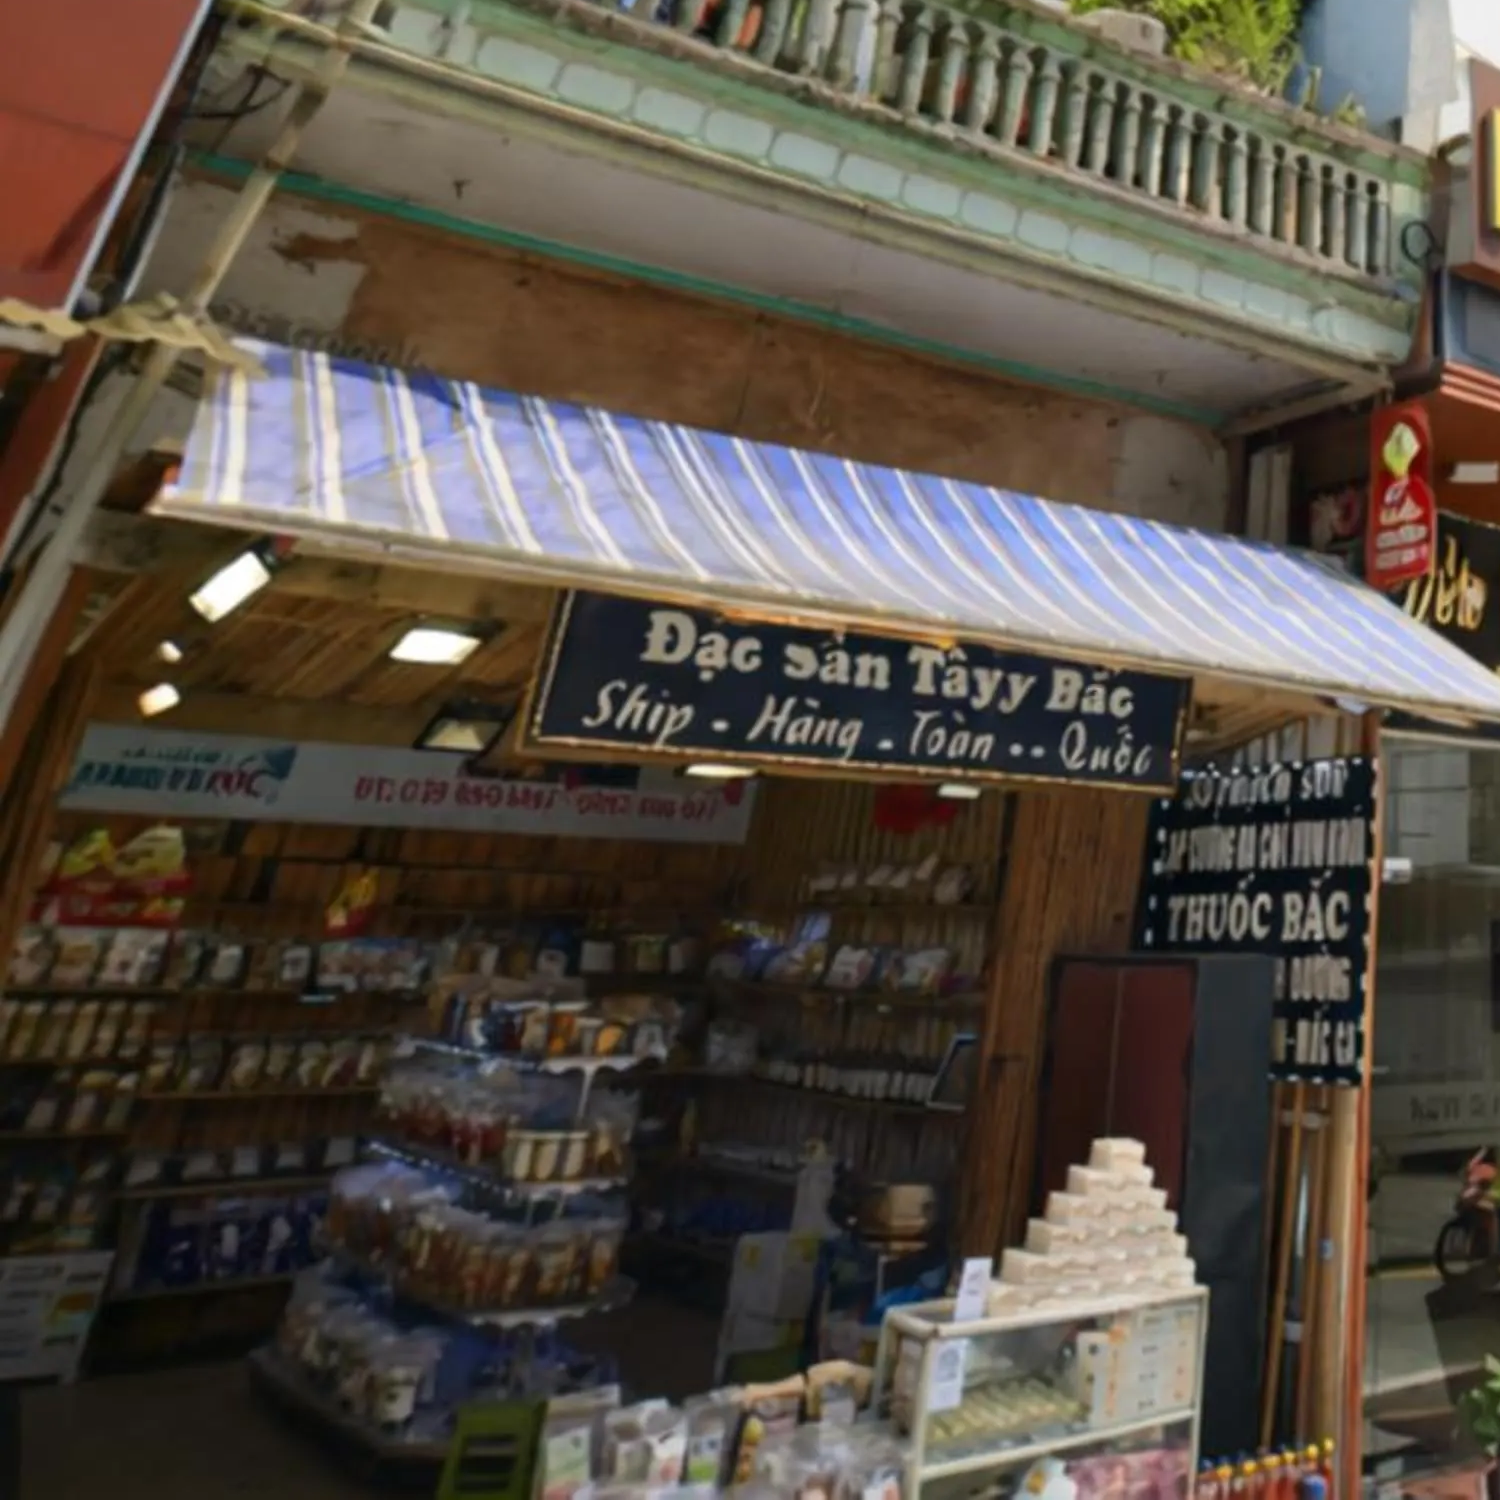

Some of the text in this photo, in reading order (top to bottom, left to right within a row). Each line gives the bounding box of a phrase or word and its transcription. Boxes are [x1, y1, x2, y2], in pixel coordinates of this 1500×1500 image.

[582, 679, 695, 747] Ship
[746, 697, 865, 761] Hàng
[908, 709, 995, 763] Toàn
[1166, 868, 1351, 942] THUỐC BẮC
